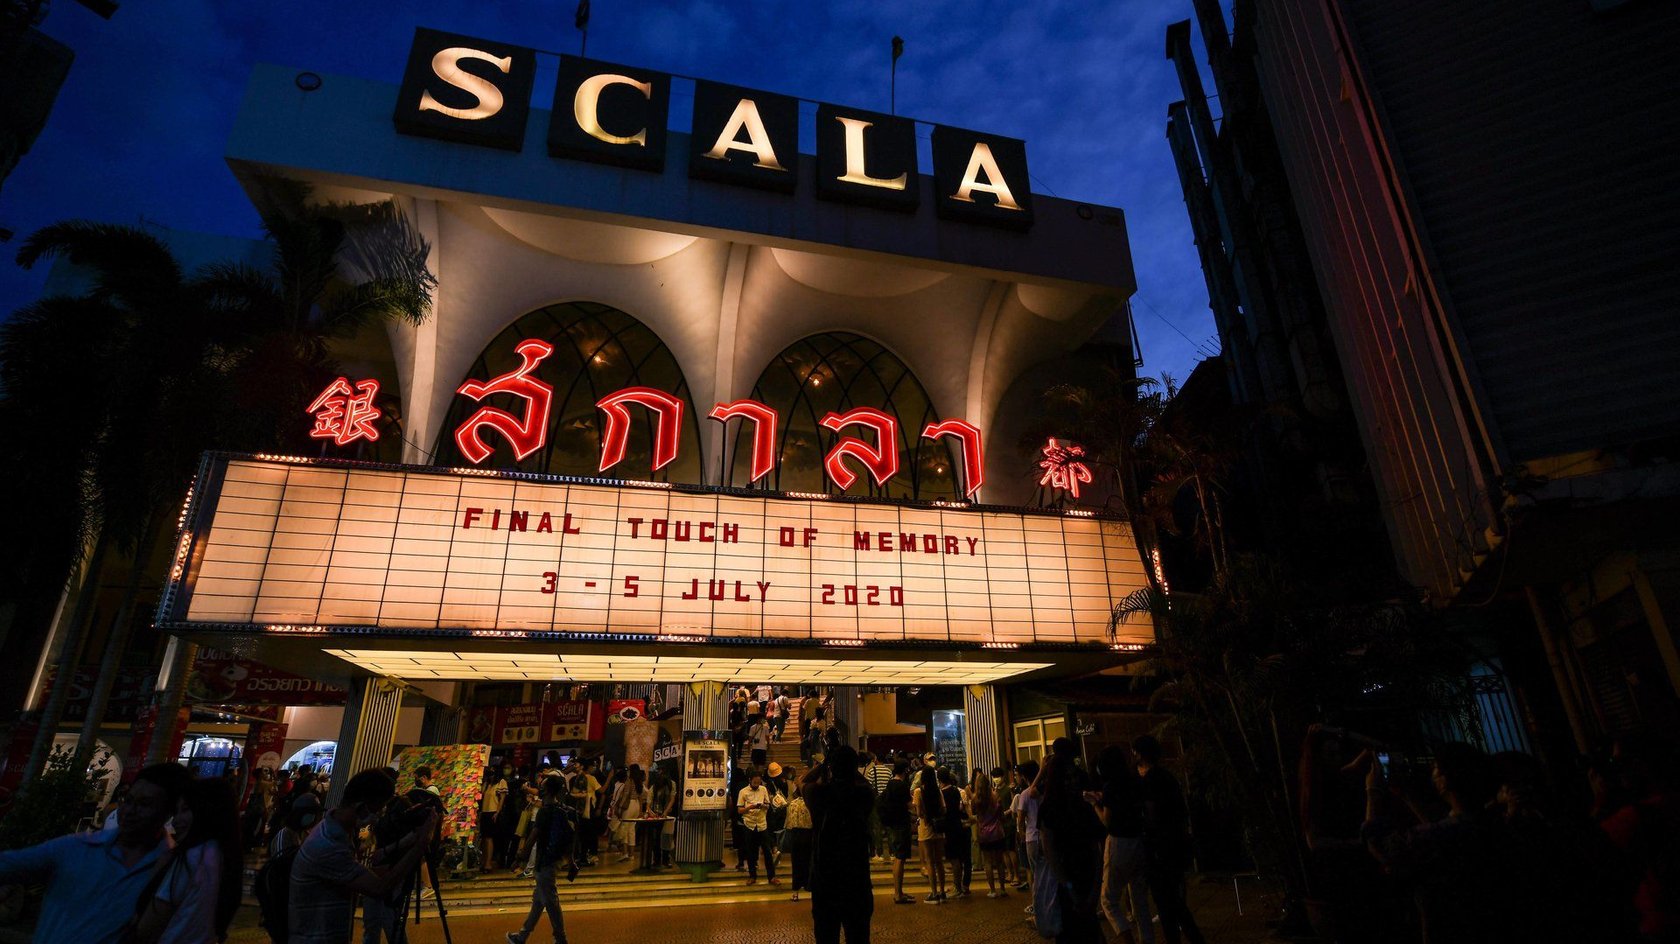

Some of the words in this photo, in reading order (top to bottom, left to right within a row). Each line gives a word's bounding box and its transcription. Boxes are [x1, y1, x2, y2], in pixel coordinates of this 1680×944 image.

[419, 46, 1022, 211] SCALA
[305, 376, 382, 446] 銀
[455, 337, 986, 501] สกาลา
[1038, 436, 1093, 499] 都
[463, 507, 581, 535] FINAL
[628, 517, 740, 544] TOUCH
[779, 526, 818, 549] OF
[853, 529, 980, 556] MEMORY
[681, 578, 771, 603] JULY
[821, 584, 904, 607] 2020
[557, 702, 585, 717] SCALA
